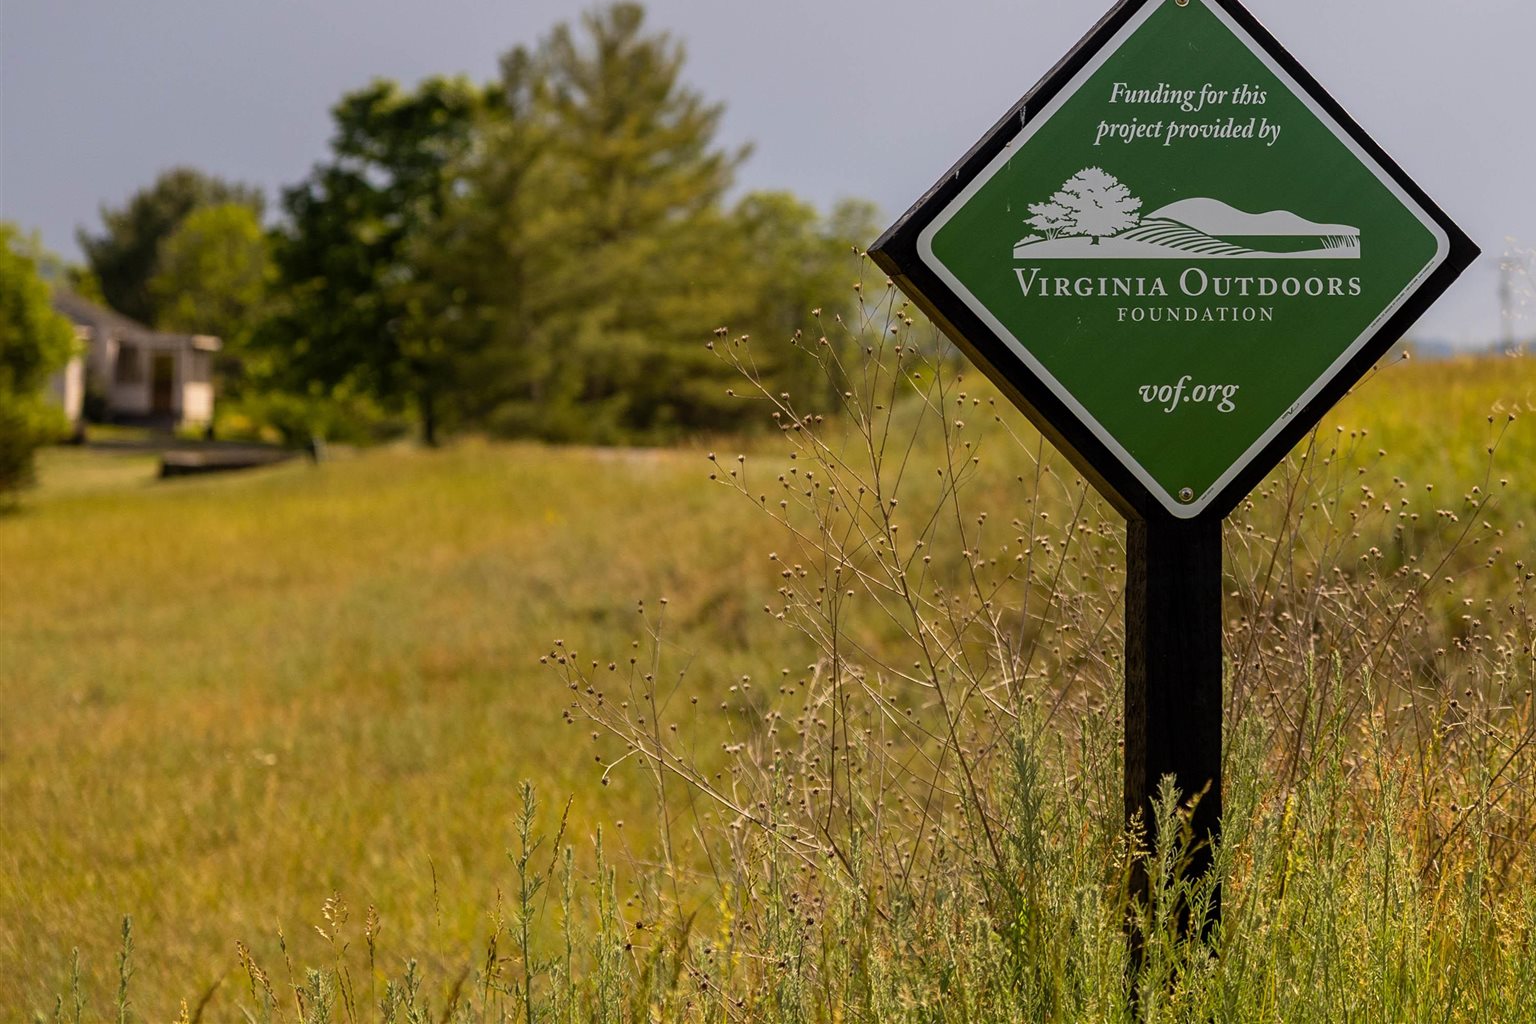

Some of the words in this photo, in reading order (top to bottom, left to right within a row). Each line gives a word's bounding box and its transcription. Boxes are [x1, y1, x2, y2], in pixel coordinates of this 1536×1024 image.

[1108, 82, 1195, 112] Funding
[1192, 84, 1228, 112] for
[1231, 82, 1267, 105] this
[1093, 118, 1163, 146] project
[1163, 117, 1255, 146] provided
[1257, 118, 1281, 147] by
[1117, 307, 1274, 322] FOUNDATION
[1138, 375, 1240, 413] vof.org
